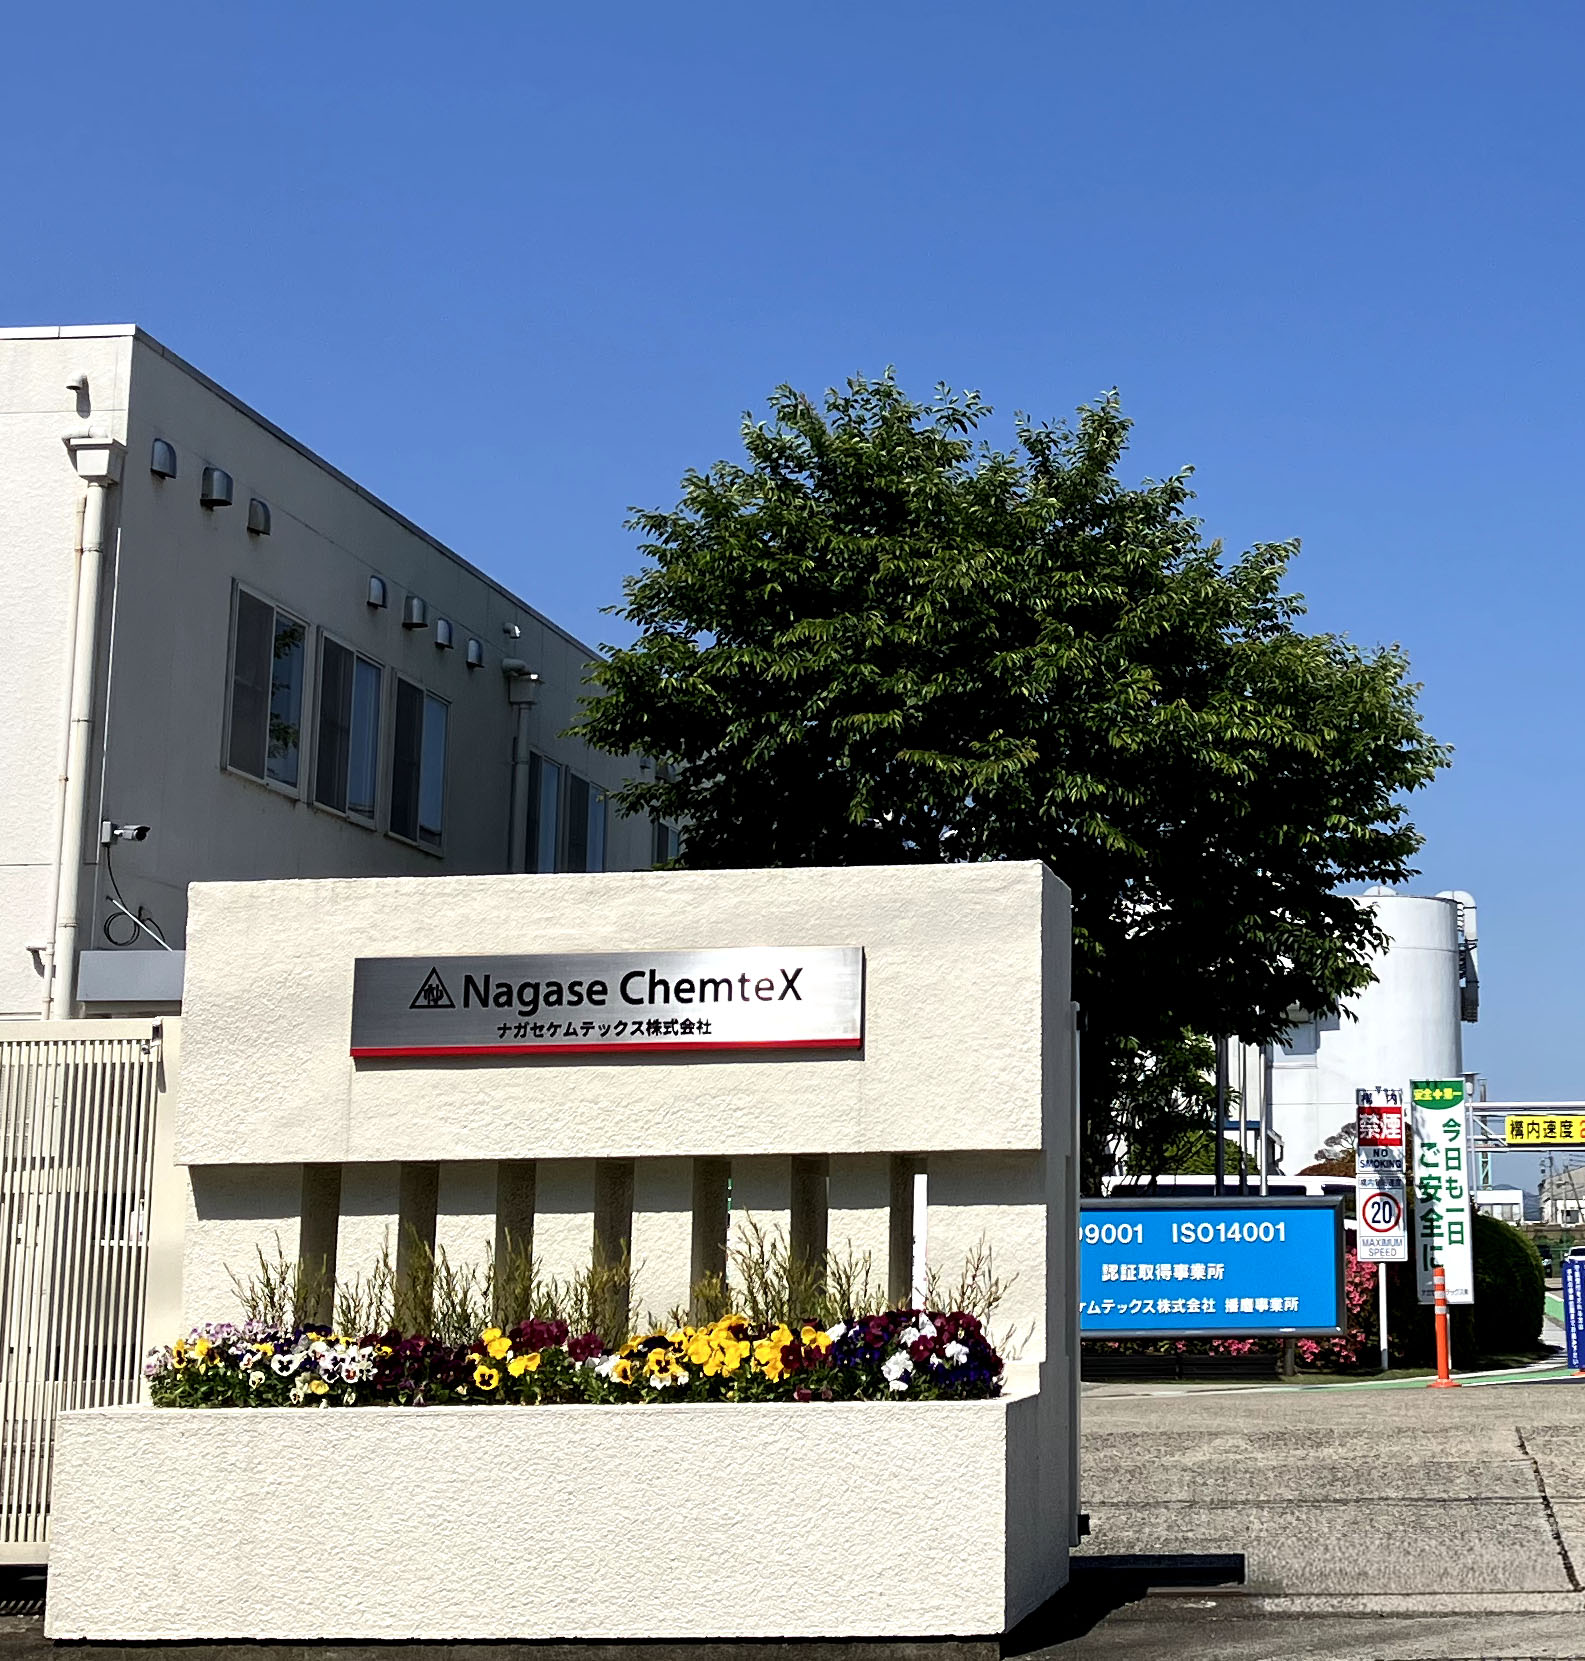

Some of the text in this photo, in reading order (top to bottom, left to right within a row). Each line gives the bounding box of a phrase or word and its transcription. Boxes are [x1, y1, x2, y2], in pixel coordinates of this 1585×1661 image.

[463, 967, 804, 1017] Nagase ChemteX
[496, 1018, 712, 1039] ナガセケムテックス株式会社
[1359, 1113, 1401, 1139] 禁煙
[1510, 1120, 1574, 1139] 構内速度
[1360, 1159, 1402, 1168] SMOKING
[1373, 1149, 1388, 1157] NO
[1443, 1118, 1464, 1245] 今日も一日
[1371, 1200, 1393, 1224] 20
[1420, 1142, 1444, 1272] ご安全に
[1079, 1222, 1285, 1244] 9001 ISO14001
[1362, 1239, 1402, 1247] MAXIMUM
[1369, 1248, 1397, 1257] SPEED
[1101, 1263, 1225, 1282] 認証取得事業所
